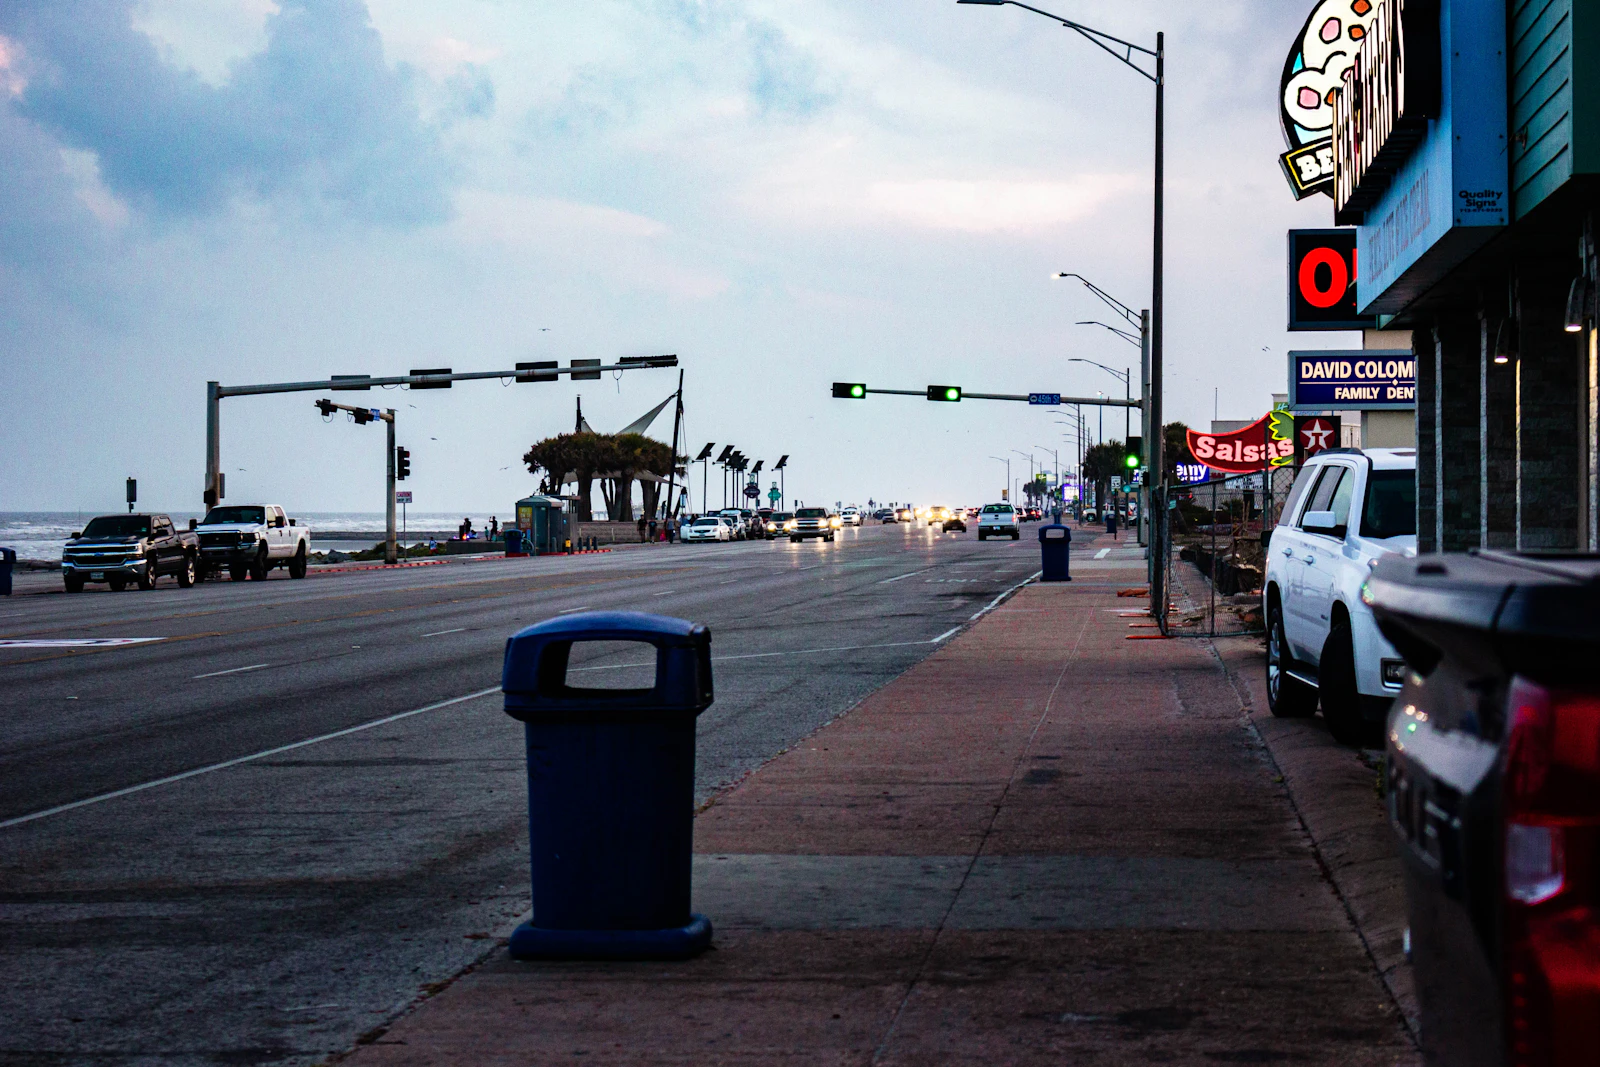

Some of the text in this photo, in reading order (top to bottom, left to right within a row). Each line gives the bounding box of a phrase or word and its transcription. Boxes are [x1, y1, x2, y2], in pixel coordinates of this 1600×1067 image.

[1296, 146, 1334, 181] BE
[1458, 190, 1502, 199] Quality
[1465, 199, 1497, 208] Signs
[1301, 361, 1352, 379] DAVID
[1037, 394, 1052, 404] 45th
[1334, 387, 1380, 400] FAMILY
[1195, 436, 1294, 463] Salsas
